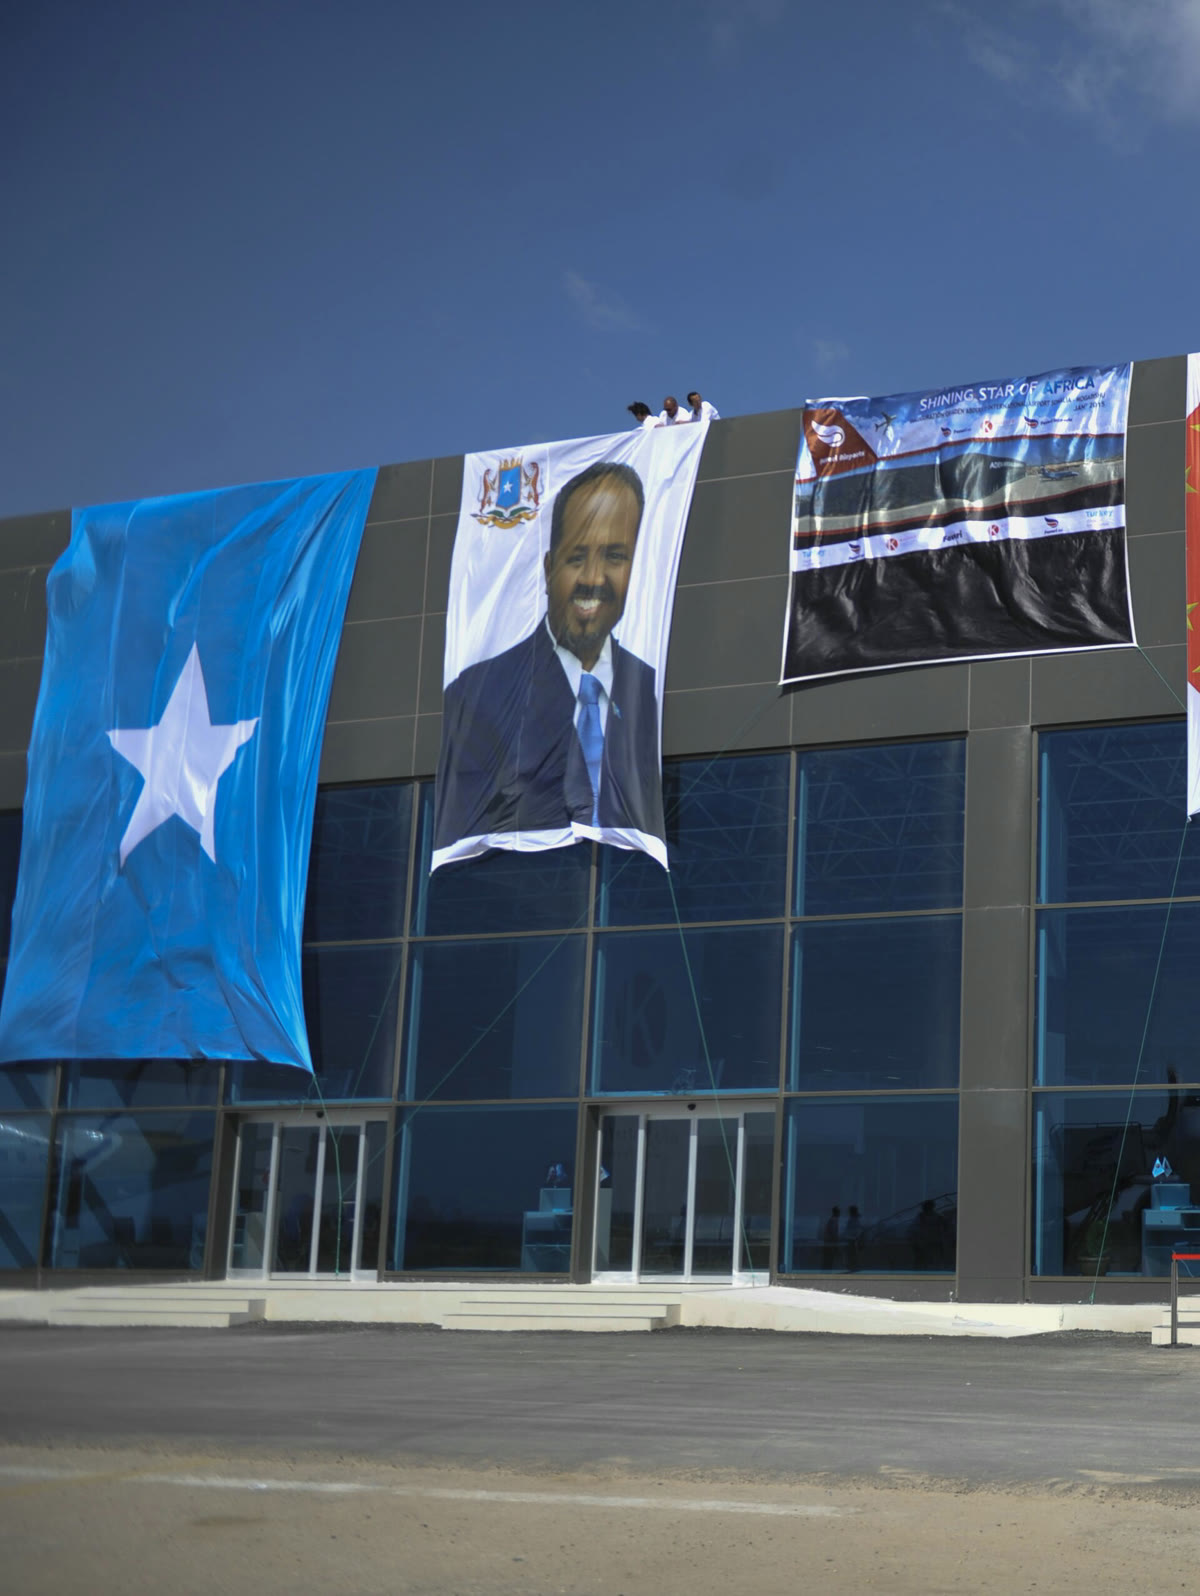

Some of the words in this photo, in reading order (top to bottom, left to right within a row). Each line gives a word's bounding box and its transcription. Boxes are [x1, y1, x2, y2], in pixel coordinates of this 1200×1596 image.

[920, 389, 974, 411] SHINING
[979, 384, 1015, 401] STAR
[1020, 381, 1039, 395] OF
[1043, 375, 1095, 394] AFRICA
